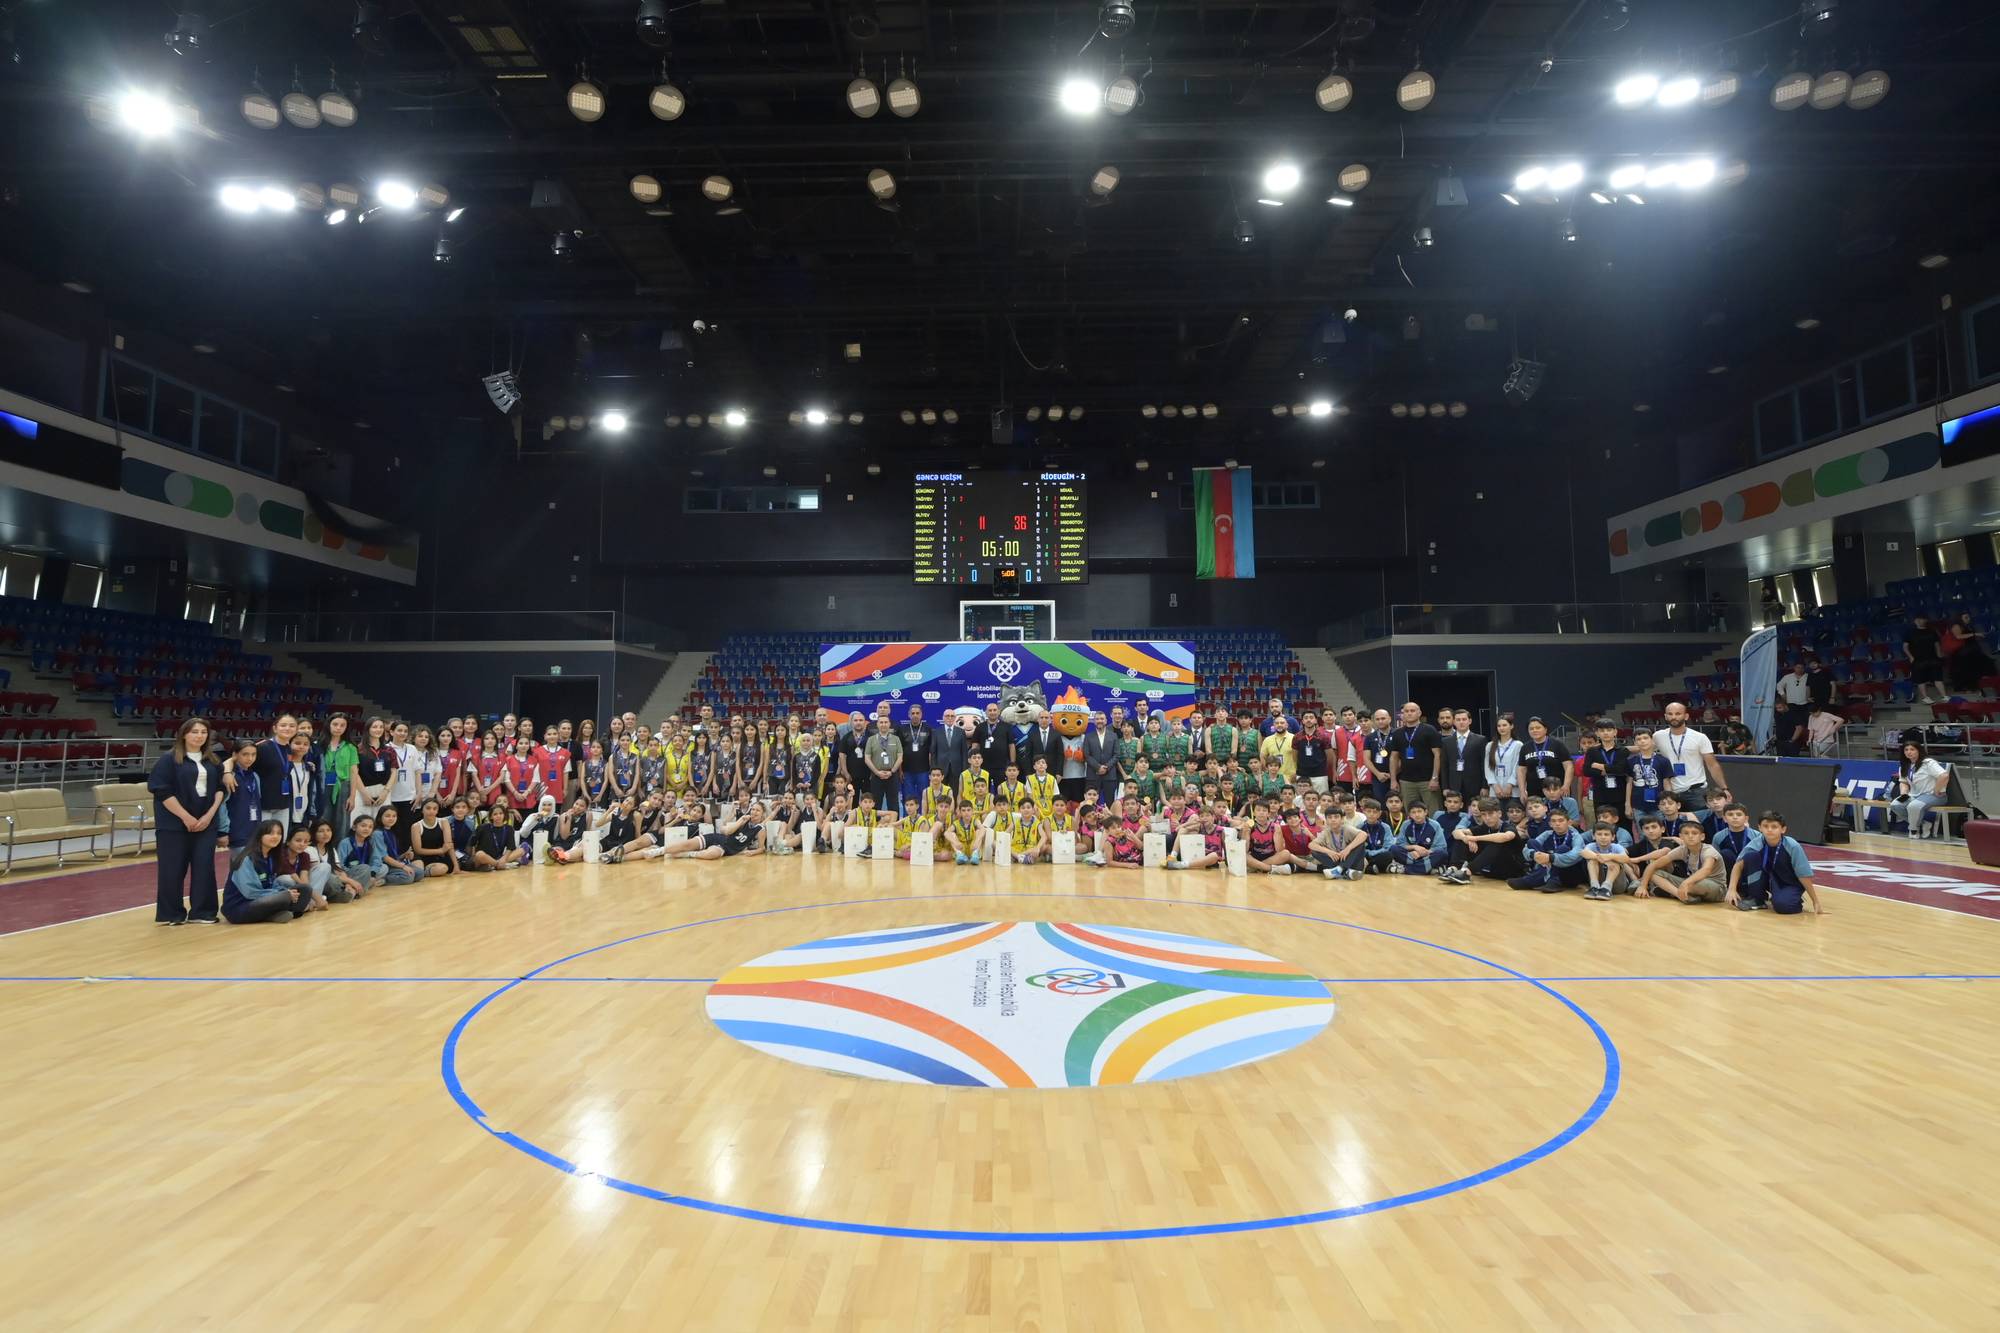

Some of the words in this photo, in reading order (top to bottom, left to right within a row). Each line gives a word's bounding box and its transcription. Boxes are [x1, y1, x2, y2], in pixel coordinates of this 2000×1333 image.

[1014, 515, 1027, 530] 36
[982, 541, 1019, 557] 05:00
[971, 569, 977, 582] 0
[1026, 569, 1032, 582] 0
[736, 832, 748, 843] 20
